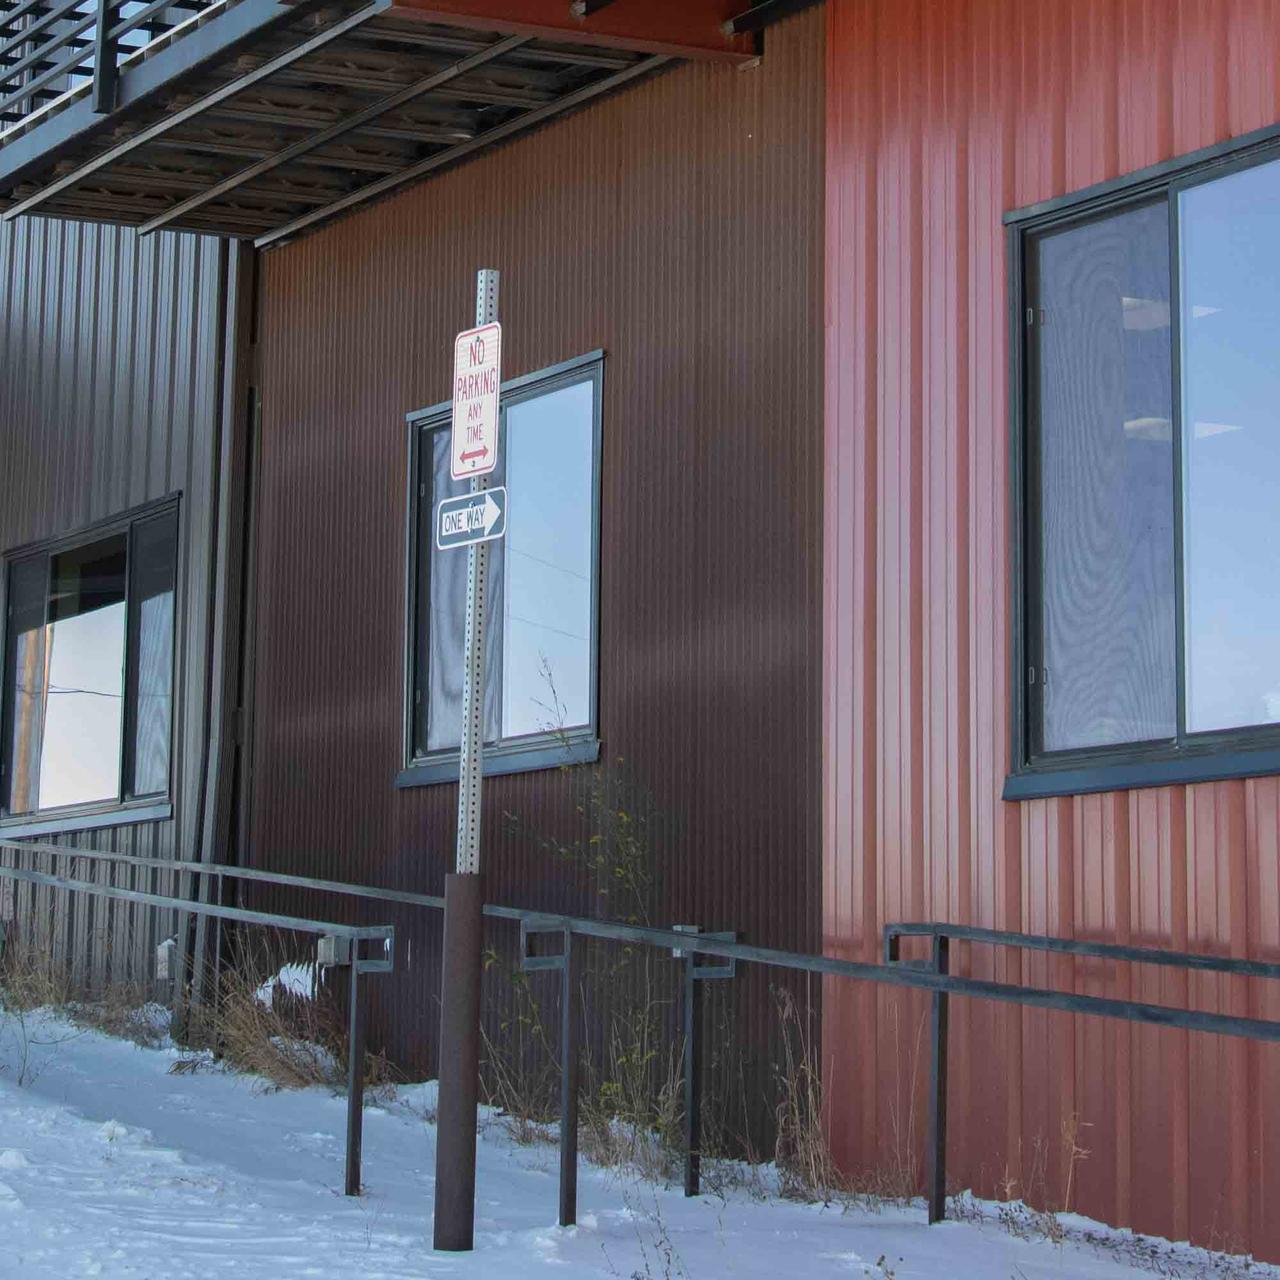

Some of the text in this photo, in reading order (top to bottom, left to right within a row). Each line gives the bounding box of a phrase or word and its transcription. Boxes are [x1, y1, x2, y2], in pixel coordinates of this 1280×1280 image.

[469, 339, 485, 368] NO
[457, 367, 496, 403] PARKING
[467, 403, 483, 421] ANY
[466, 423, 484, 444] TIME
[445, 507, 485, 532] ONE WAY
